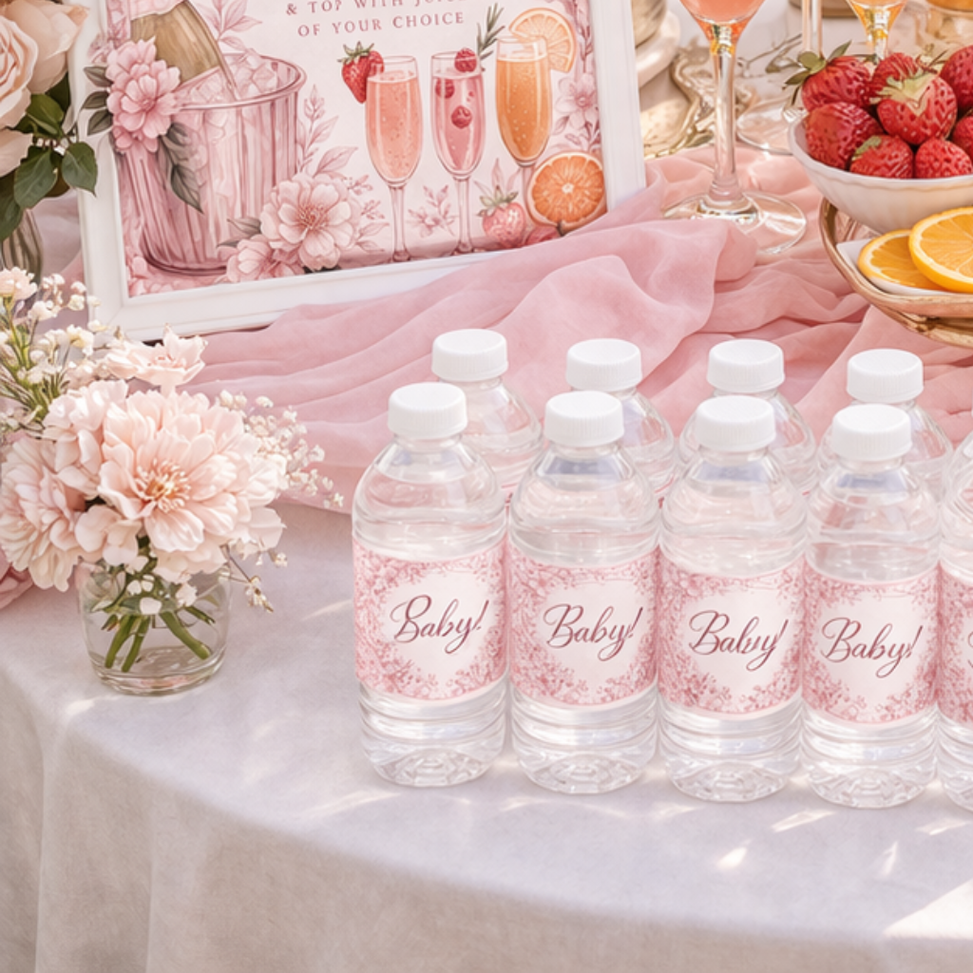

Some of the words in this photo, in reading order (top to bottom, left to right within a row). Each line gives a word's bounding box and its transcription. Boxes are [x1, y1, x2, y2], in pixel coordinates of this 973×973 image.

[286, 3, 297, 16] &
[298, 24, 320, 37] OF
[332, 18, 382, 34] YOUR
[393, 11, 464, 29] CHOICE
[390, 594, 489, 654] Baby!
[543, 604, 643, 661] Baby!
[821, 617, 923, 678] Baby!
